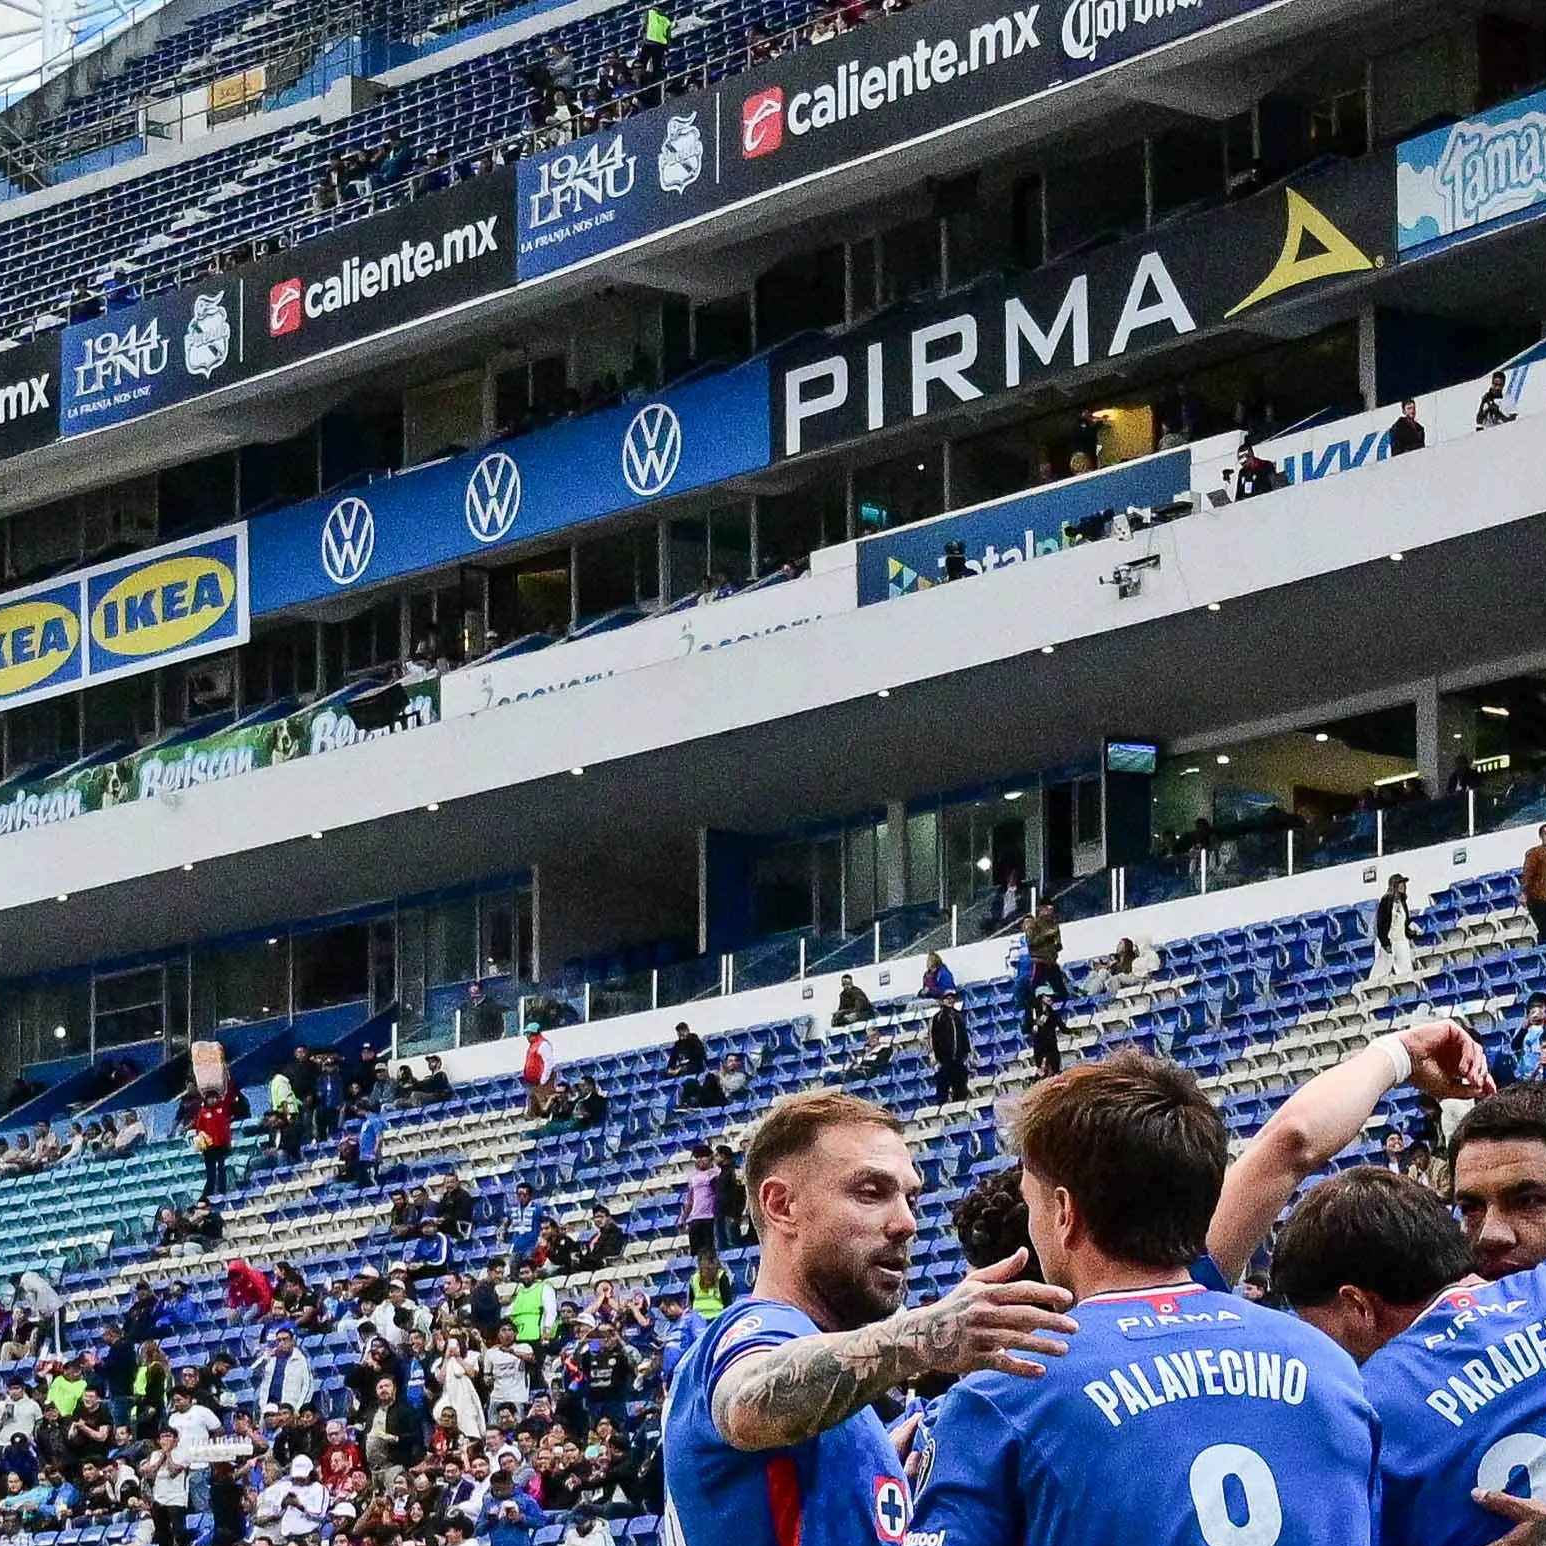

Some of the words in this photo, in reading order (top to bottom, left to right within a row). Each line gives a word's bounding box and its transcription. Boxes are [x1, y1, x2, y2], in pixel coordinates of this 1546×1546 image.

[1061, 0, 1203, 61] Coro
[786, 4, 1041, 137] caliente.mx
[529, 155, 637, 229] LFNU
[538, 134, 626, 196] 1944
[534, 229, 572, 248] FRANJA
[572, 220, 593, 237] NOS
[304, 214, 499, 320] caliente.mx
[74, 338, 171, 397] LFNU
[83, 317, 161, 370] 1944
[785, 251, 1196, 456] PIRMA
[103, 572, 224, 640] IKEA
[1117, 1306, 1242, 1333] PIRMA
[1424, 1298, 1529, 1350] PIRMA
[1083, 1346, 1309, 1427] PALAVECINO
